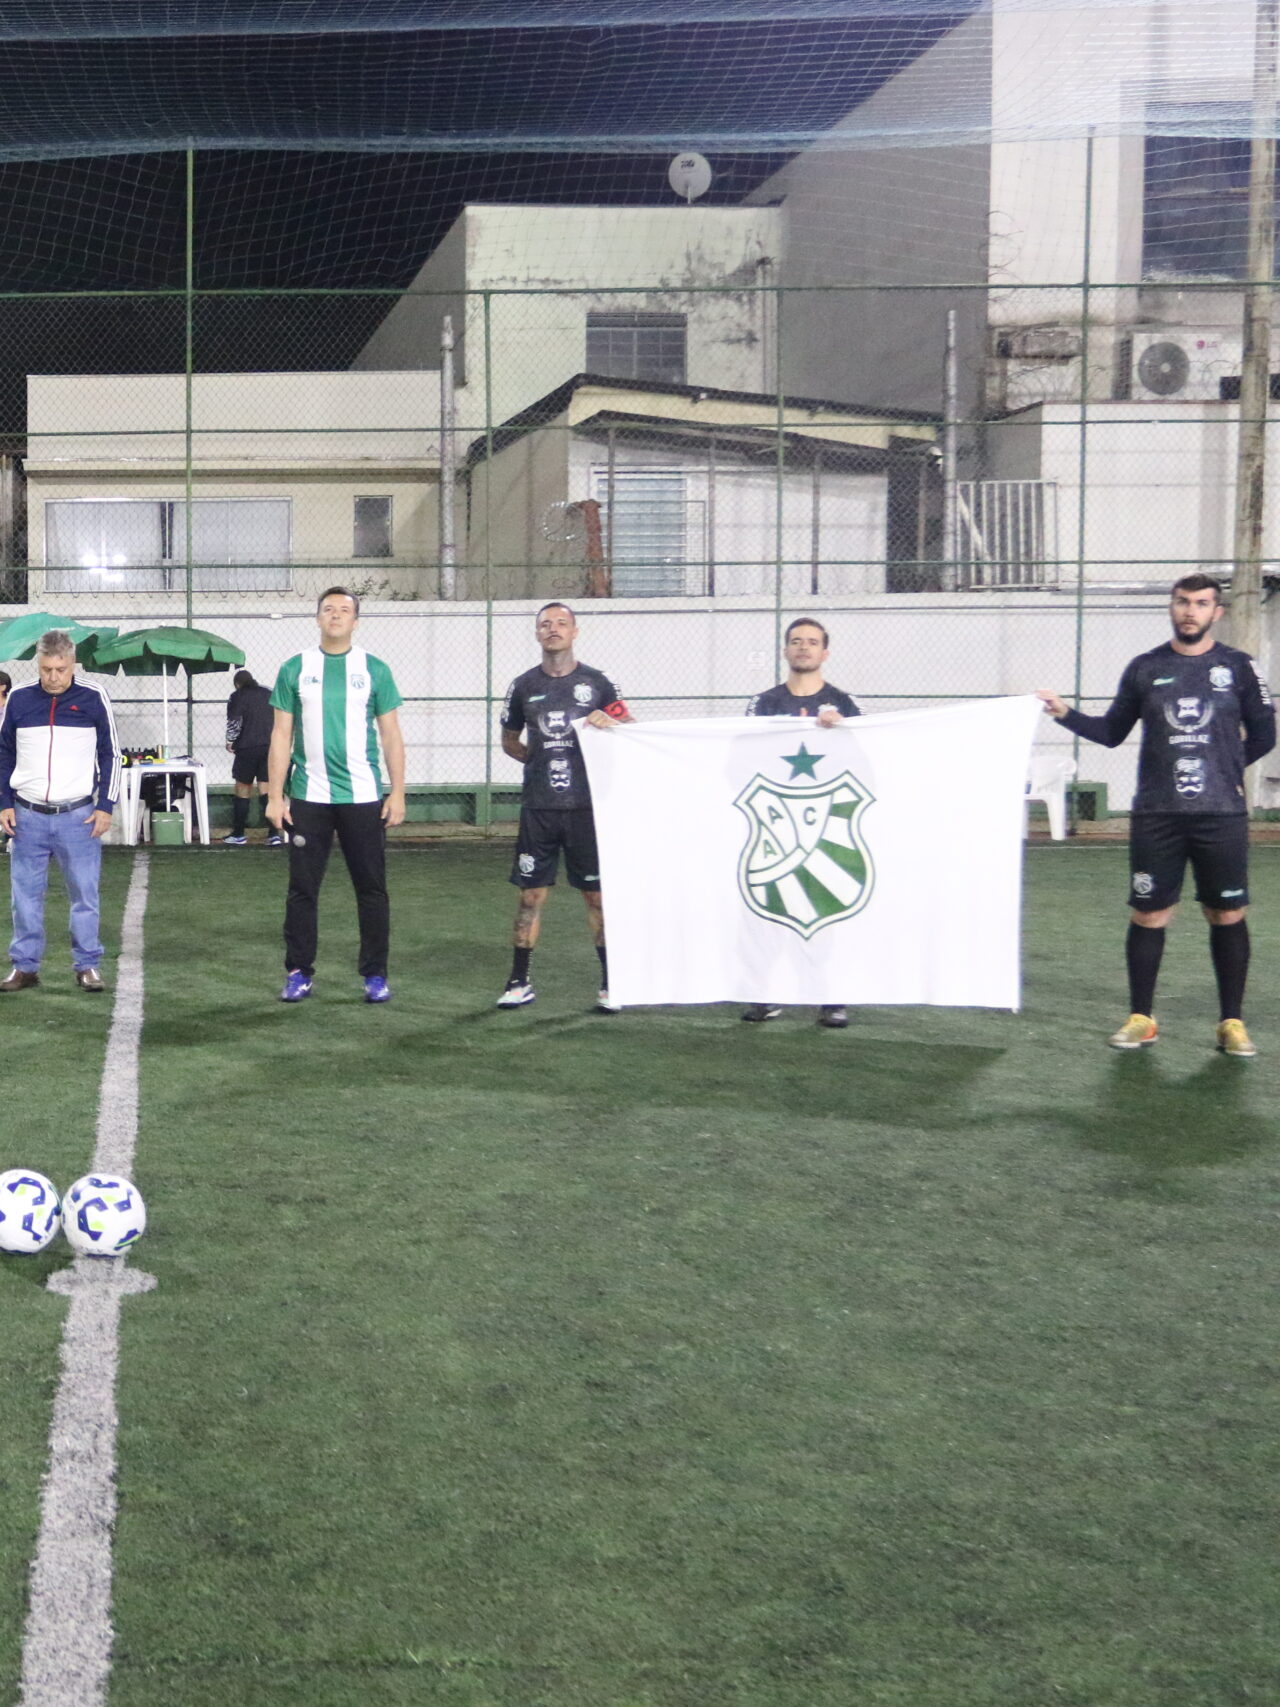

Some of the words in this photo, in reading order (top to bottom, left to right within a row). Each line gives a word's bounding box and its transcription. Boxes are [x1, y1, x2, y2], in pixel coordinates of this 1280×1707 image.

[766, 805, 784, 825] A
[803, 806, 817, 826] C
[762, 839, 778, 859] A
